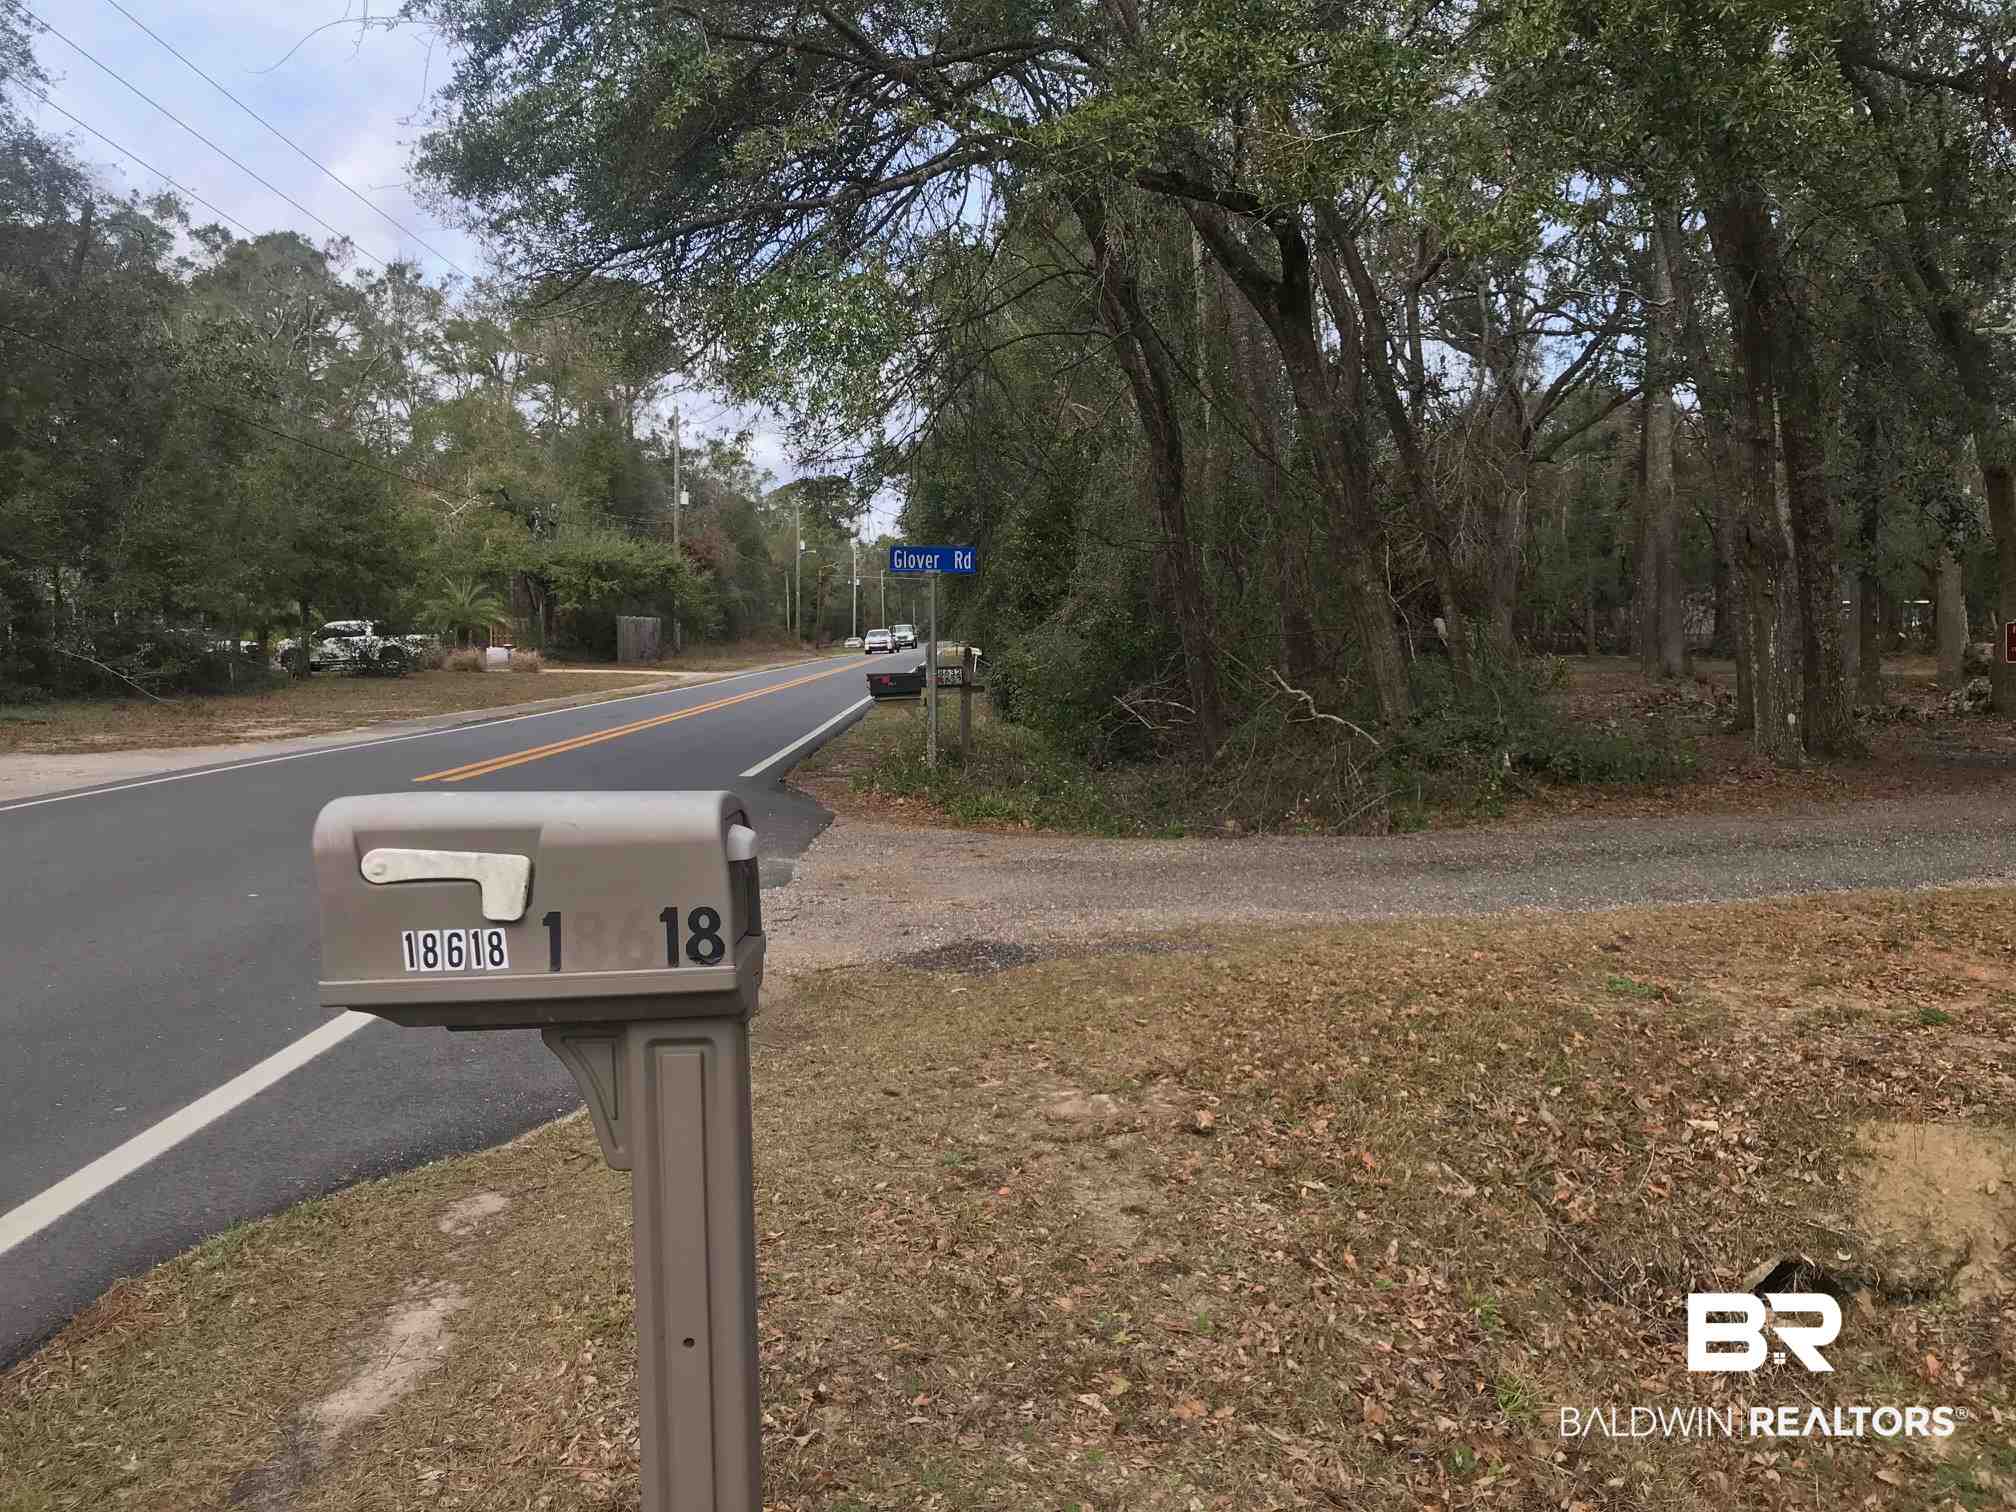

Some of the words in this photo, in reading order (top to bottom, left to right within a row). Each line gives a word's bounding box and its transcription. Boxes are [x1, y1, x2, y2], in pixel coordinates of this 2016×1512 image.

[894, 550, 940, 569] Glover
[954, 550, 972, 569] Rd
[403, 929, 505, 970] 18618
